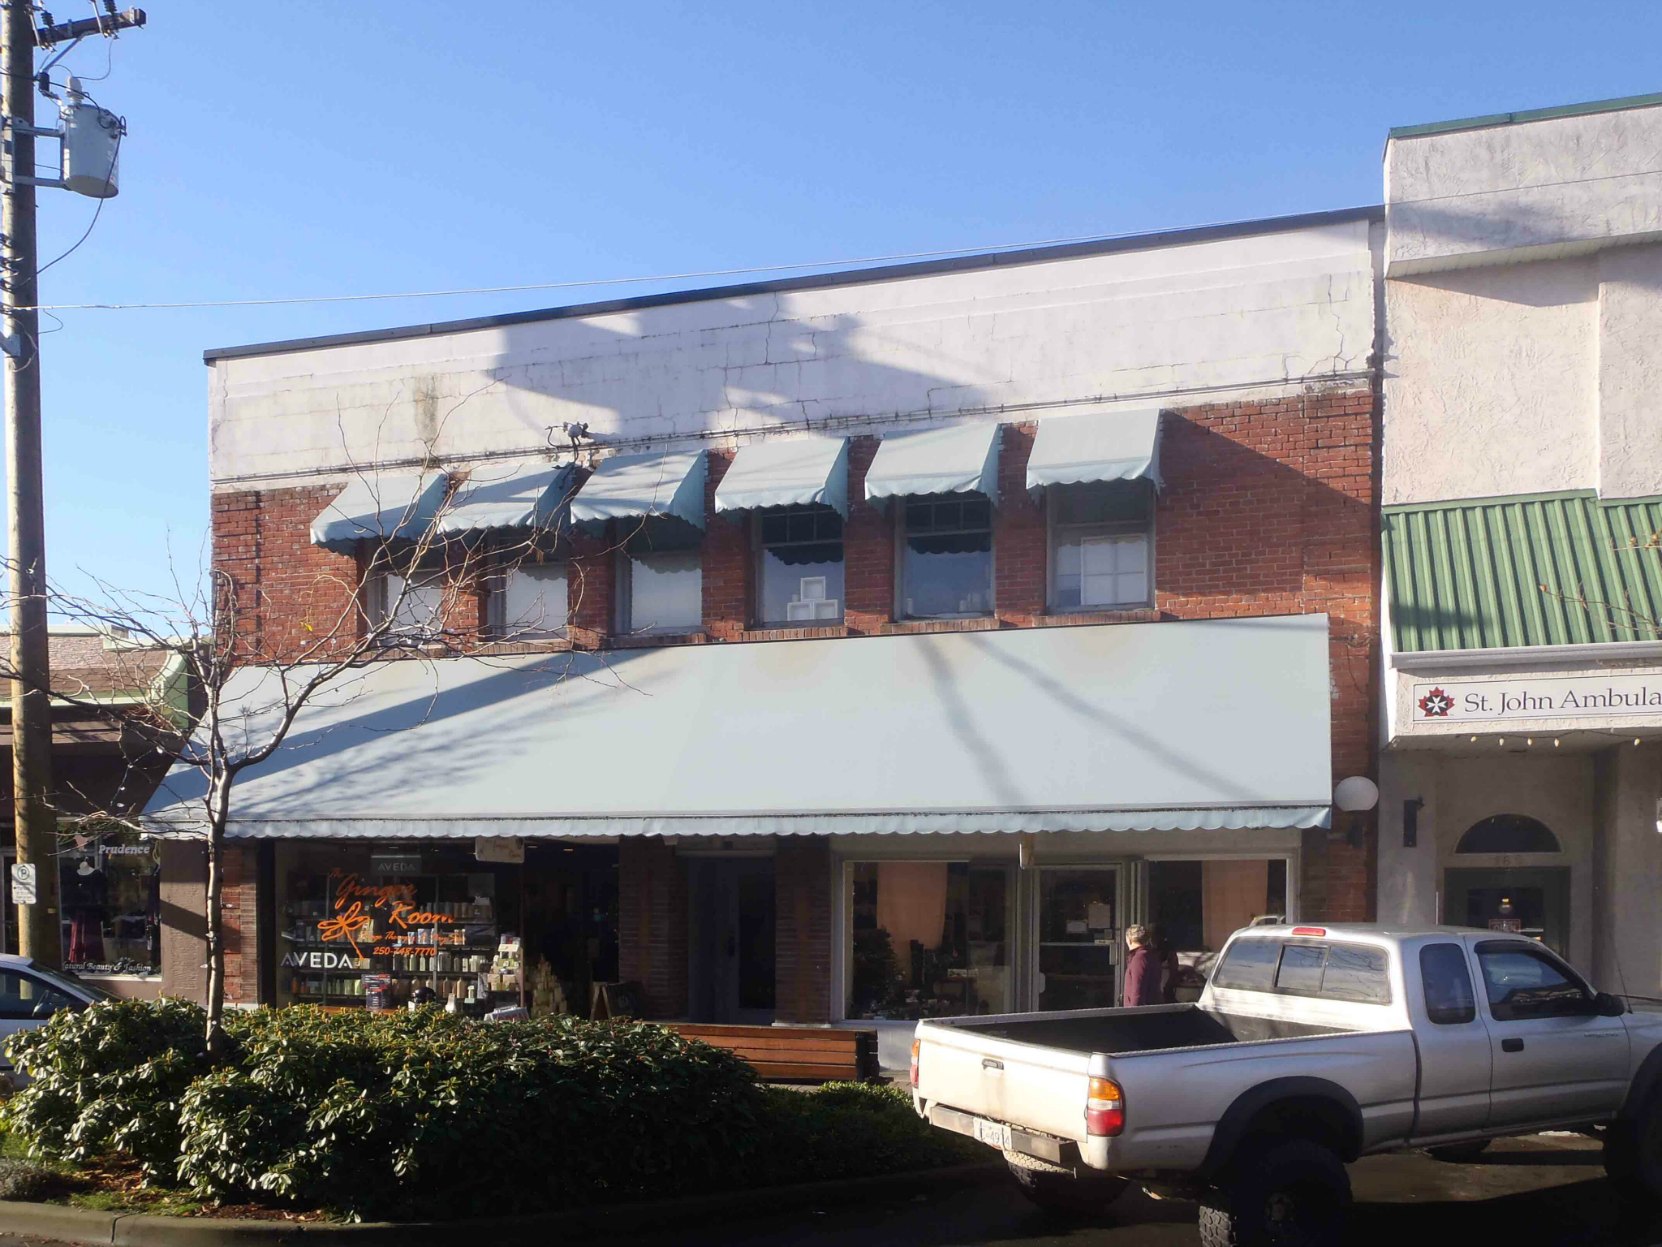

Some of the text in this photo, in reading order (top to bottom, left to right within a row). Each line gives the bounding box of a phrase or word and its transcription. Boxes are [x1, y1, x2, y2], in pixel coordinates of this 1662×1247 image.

[1464, 686, 1662, 715] St. John Ambula
[99, 843, 150, 855] Prudence
[378, 863, 416, 872] AVEDA
[388, 900, 455, 929] Room
[113, 961, 122, 971] &
[280, 952, 353, 969] AVEDA
